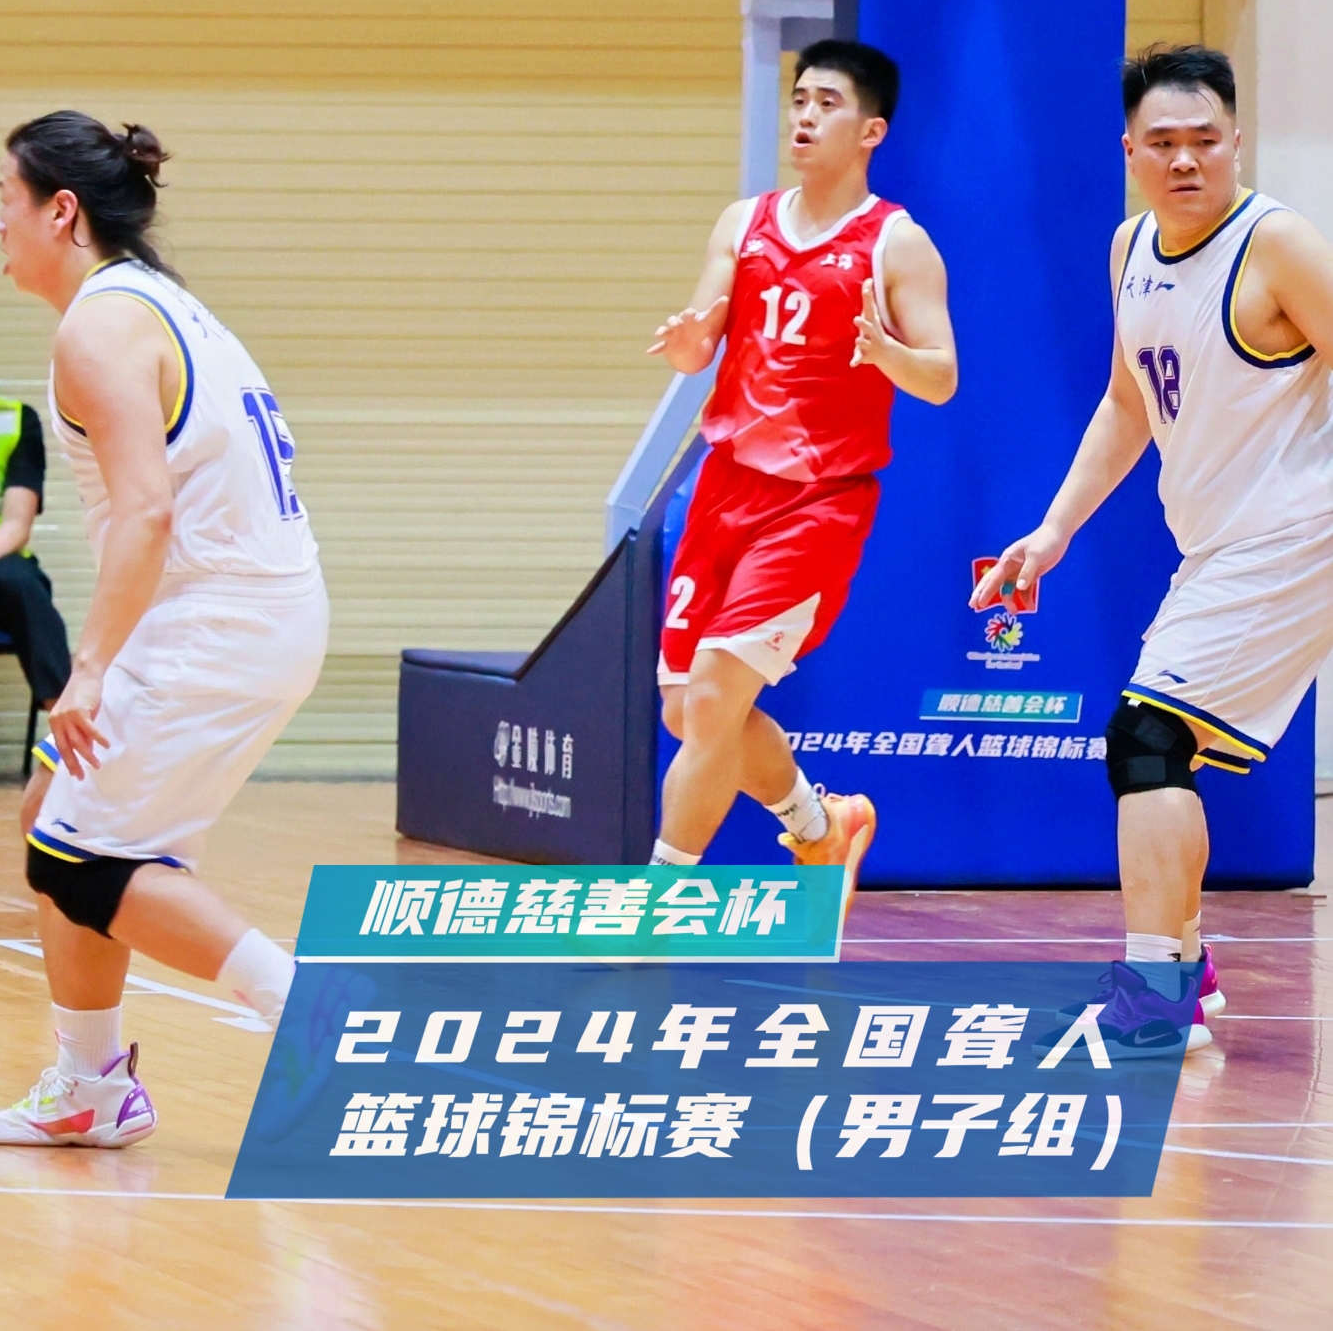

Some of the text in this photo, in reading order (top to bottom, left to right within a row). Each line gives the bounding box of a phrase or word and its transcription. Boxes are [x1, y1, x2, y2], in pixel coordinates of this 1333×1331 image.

[759, 284, 811, 346] 12
[1124, 274, 1154, 300] 天津
[1136, 345, 1181, 424] 18
[665, 574, 696, 630] 2
